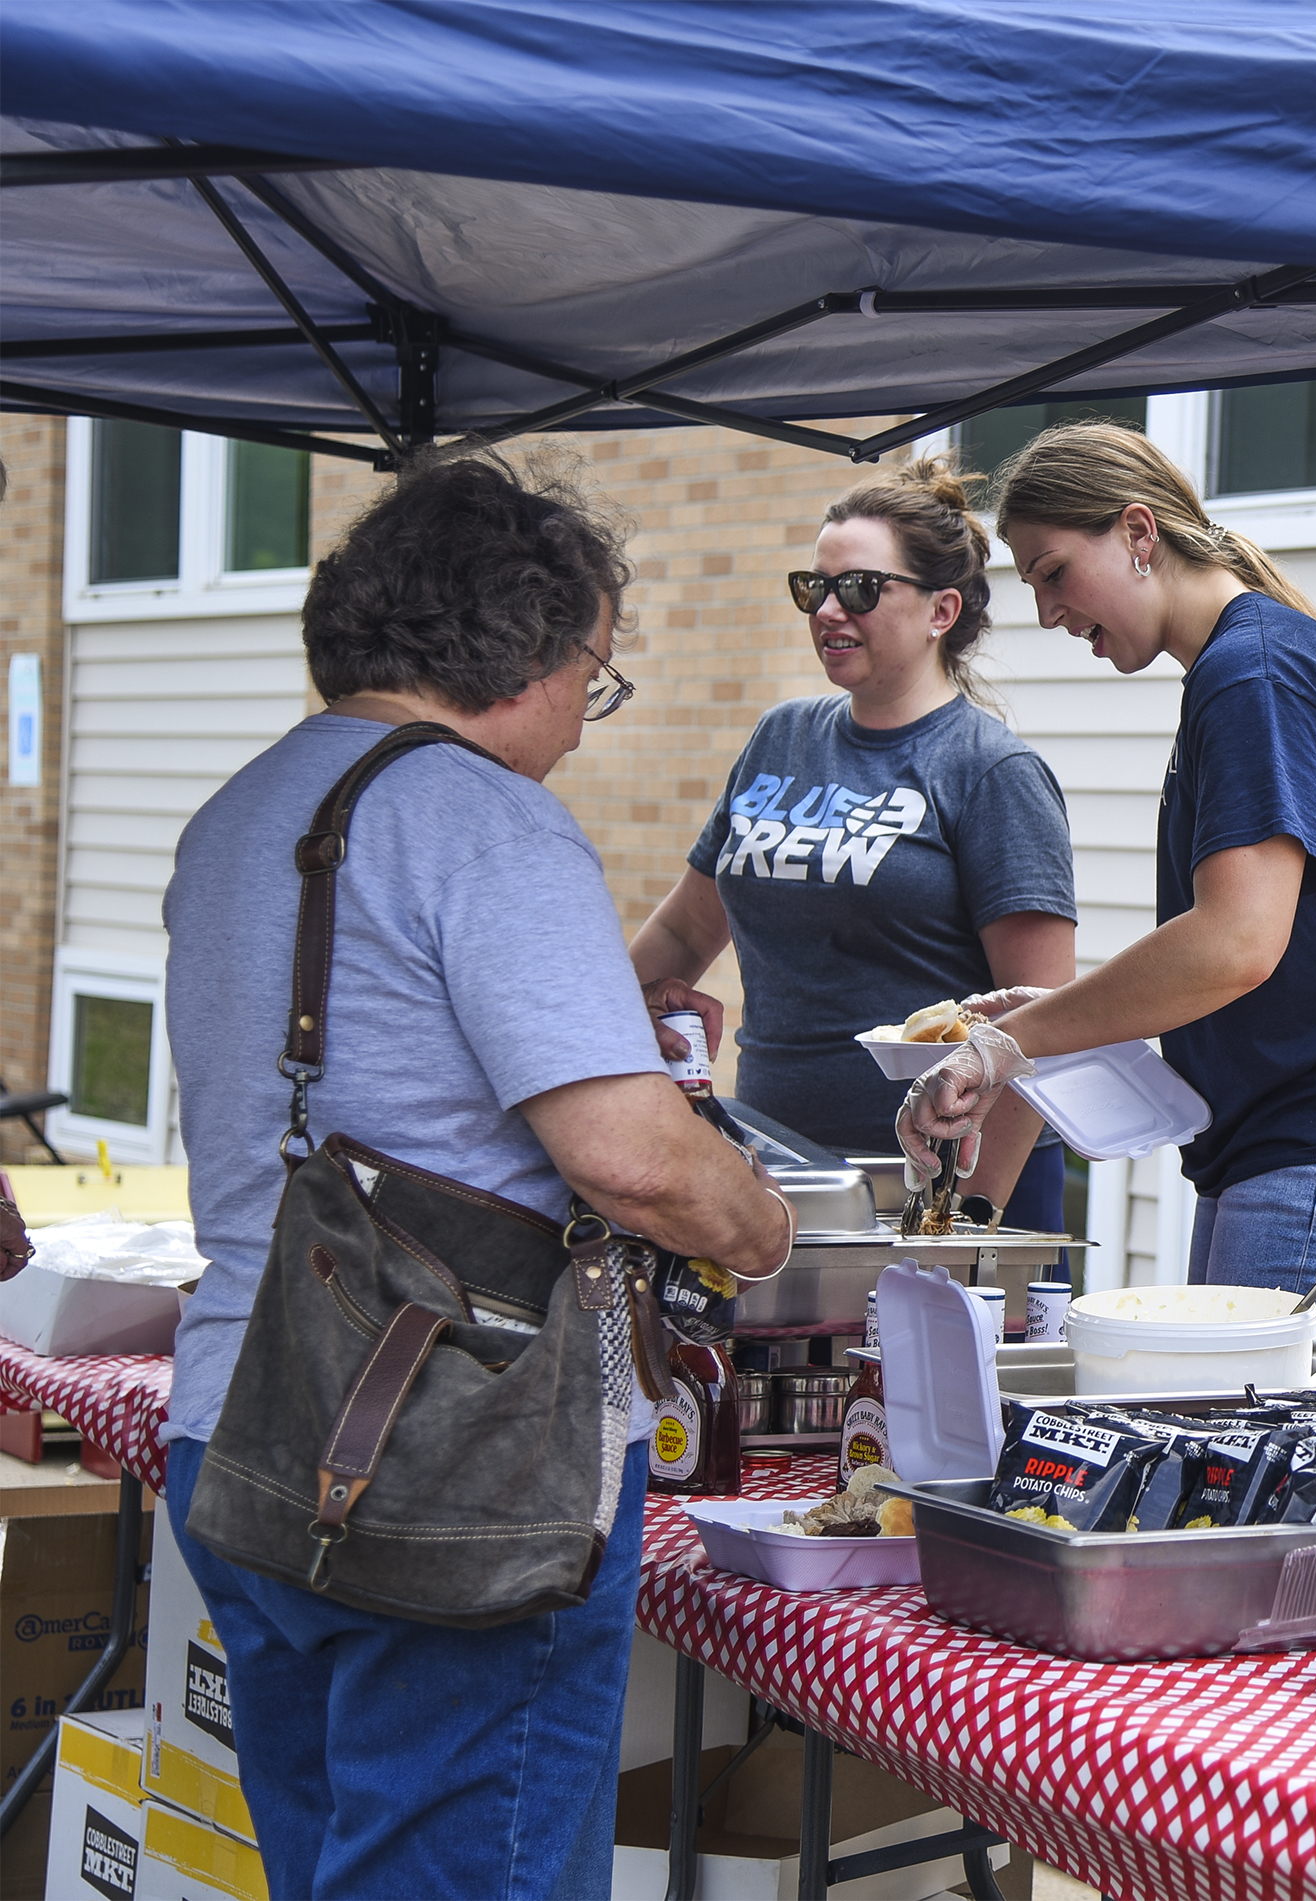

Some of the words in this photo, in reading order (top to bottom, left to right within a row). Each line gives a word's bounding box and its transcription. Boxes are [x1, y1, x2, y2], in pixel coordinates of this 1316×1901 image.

[731, 772, 872, 829] BLUE
[716, 814, 901, 886] CREW
[1029, 1323, 1048, 1336] Boss!
[846, 1411, 860, 1430] SWEET
[860, 1410, 875, 1422] BABY
[1035, 1415, 1115, 1443] COBBLESTREET
[658, 1431, 684, 1446] Barbecue
[852, 1441, 872, 1454] Hickory
[1029, 1424, 1111, 1455] MKT.
[864, 1452, 880, 1463] Sugar
[1024, 1457, 1089, 1487] RIPPLE
[1013, 1475, 1053, 1494] POTATO
[15, 1611, 112, 1642] amerCa
[11, 1698, 27, 1719] 6
[34, 1695, 57, 1717] in
[189, 1692, 233, 1730] BBLESTREET
[86, 1826, 137, 1866] COBBLESTREET
[83, 1849, 133, 1895] MKT.
